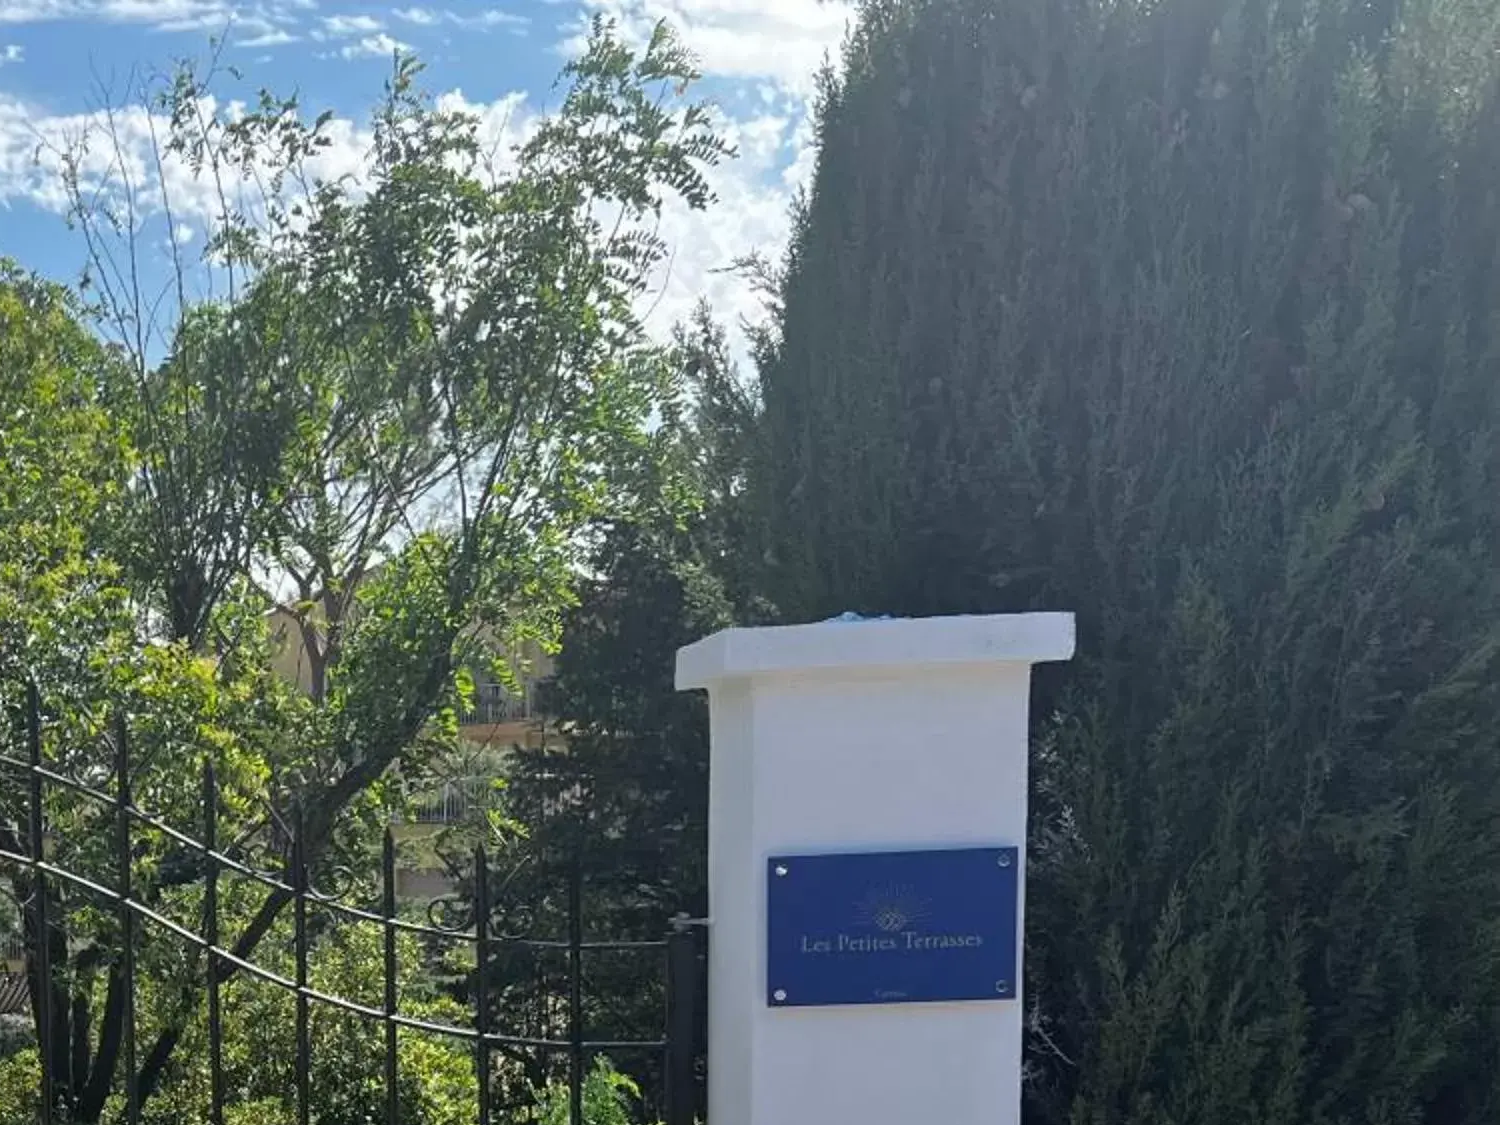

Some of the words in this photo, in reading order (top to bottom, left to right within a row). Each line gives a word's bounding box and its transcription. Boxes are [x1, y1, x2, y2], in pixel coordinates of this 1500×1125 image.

[802, 935, 831, 953] Les
[839, 934, 896, 952] Petites
[901, 931, 984, 949] Terrasses
